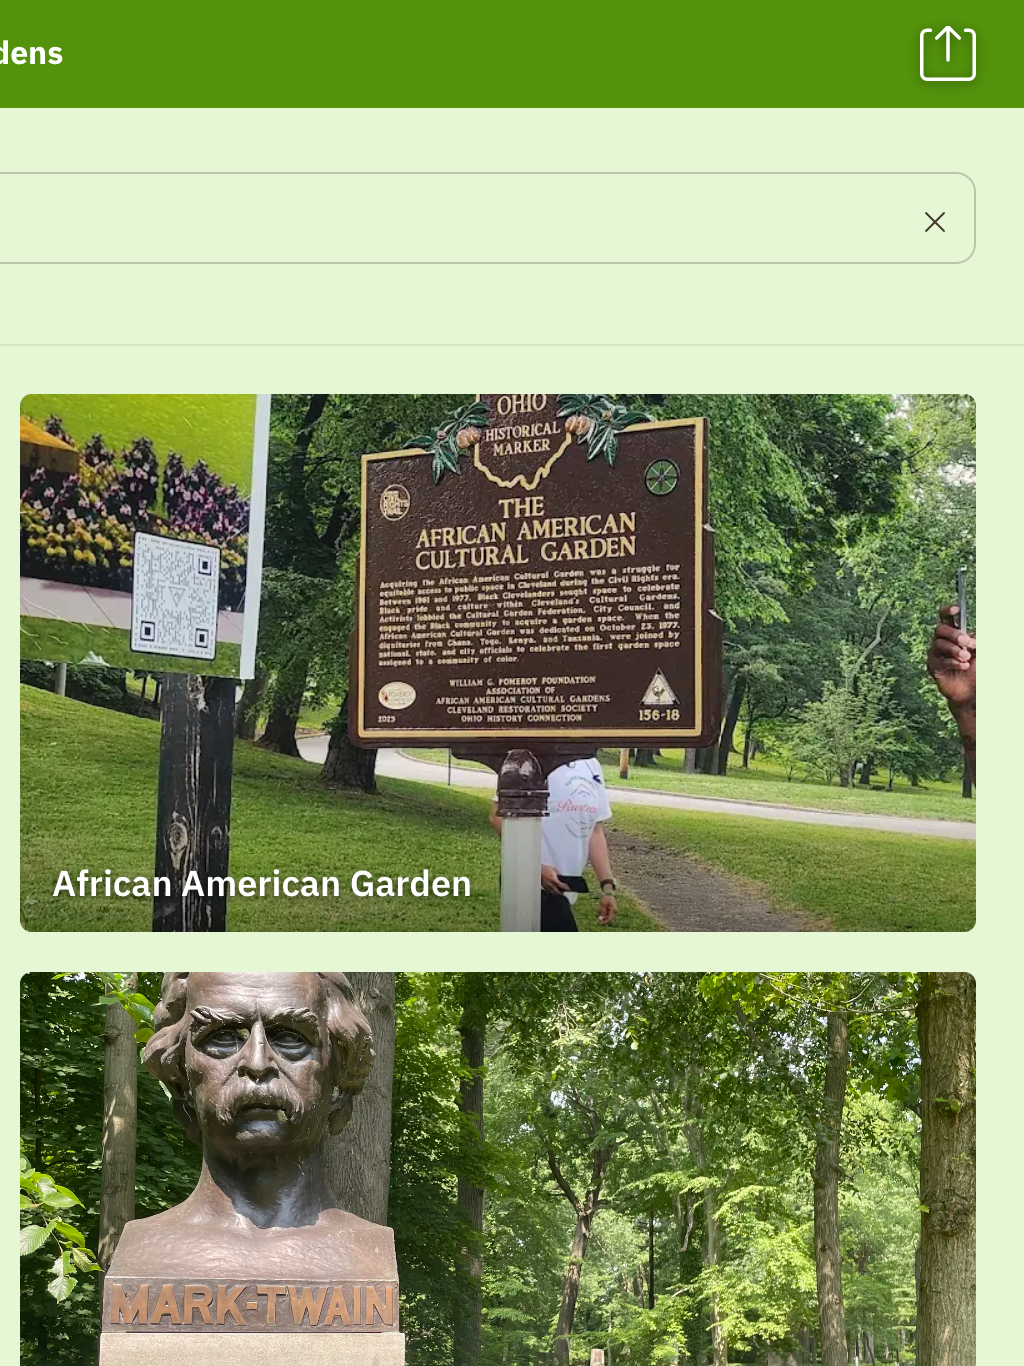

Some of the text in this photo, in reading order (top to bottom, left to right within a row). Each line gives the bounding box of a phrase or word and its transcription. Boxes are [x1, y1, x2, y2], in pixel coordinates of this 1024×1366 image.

[497, 394, 547, 417] OHIO
[485, 421, 561, 442] HISTORICAL
[493, 438, 551, 457] MARKER
[498, 496, 545, 519] THE
[416, 511, 637, 549] AFRICAN AMERICAN
[416, 535, 637, 570] CULTURAL GARDEN
[379, 580, 418, 589] Acquiring
[422, 579, 435, 587] the
[472, 575, 510, 584] American
[514, 571, 549, 581] Cultural
[554, 570, 584, 578] Garden
[590, 568, 606, 576] was
[622, 565, 661, 574] struggle
[665, 563, 680, 572] for
[379, 589, 415, 598] equitable
[417, 587, 442, 595] access
[455, 585, 479, 595] public
[482, 584, 504, 592] space
[518, 580, 557, 590] Cleveland
[560, 578, 588, 588] during
[608, 575, 629, 584] Civil
[631, 574, 659, 584] Rights
[449, 676, 596, 687] WILLIAM POMEROY FOUNDATION
[486, 686, 556, 695] ASSOCIATION OF
[436, 694, 611, 705] AFRICAN AMERICAN CULTURAL GARDENS
[447, 704, 599, 714] CLEVELAND RESTORATION SOCIETY
[461, 714, 582, 723] OHIO HISTORY CONNECTION
[639, 709, 680, 721] 156-18
